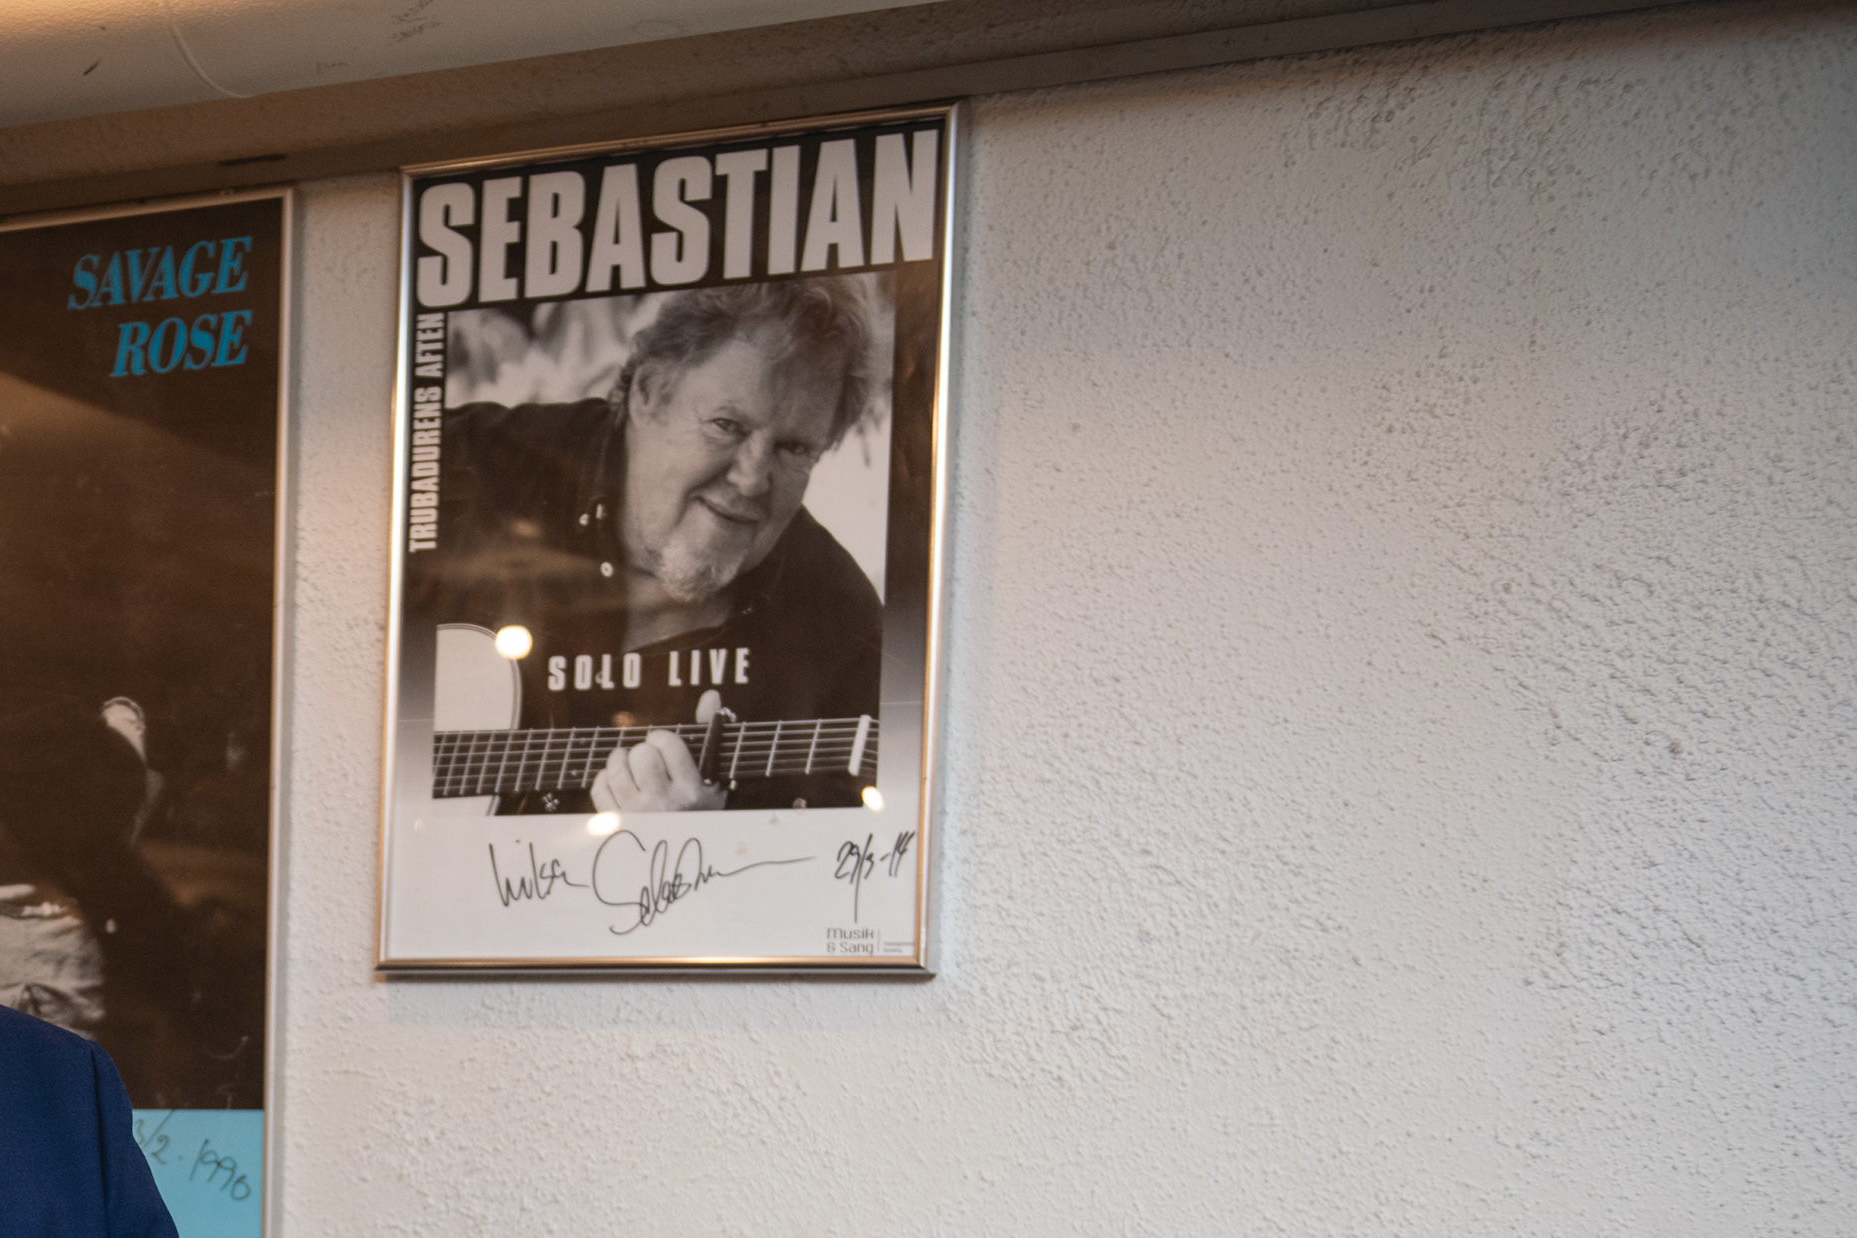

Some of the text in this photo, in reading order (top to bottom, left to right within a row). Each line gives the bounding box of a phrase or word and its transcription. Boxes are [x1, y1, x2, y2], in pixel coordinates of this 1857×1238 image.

[416, 128, 939, 307] SEBASTIAN
[67, 235, 253, 310] SAVAGE
[109, 309, 253, 377] ROSE
[409, 312, 445, 552] TRUBADURENS AFTEN
[548, 647, 750, 691] SOLO LIVE
[826, 942, 835, 953] &
[839, 941, 874, 956] Sang
